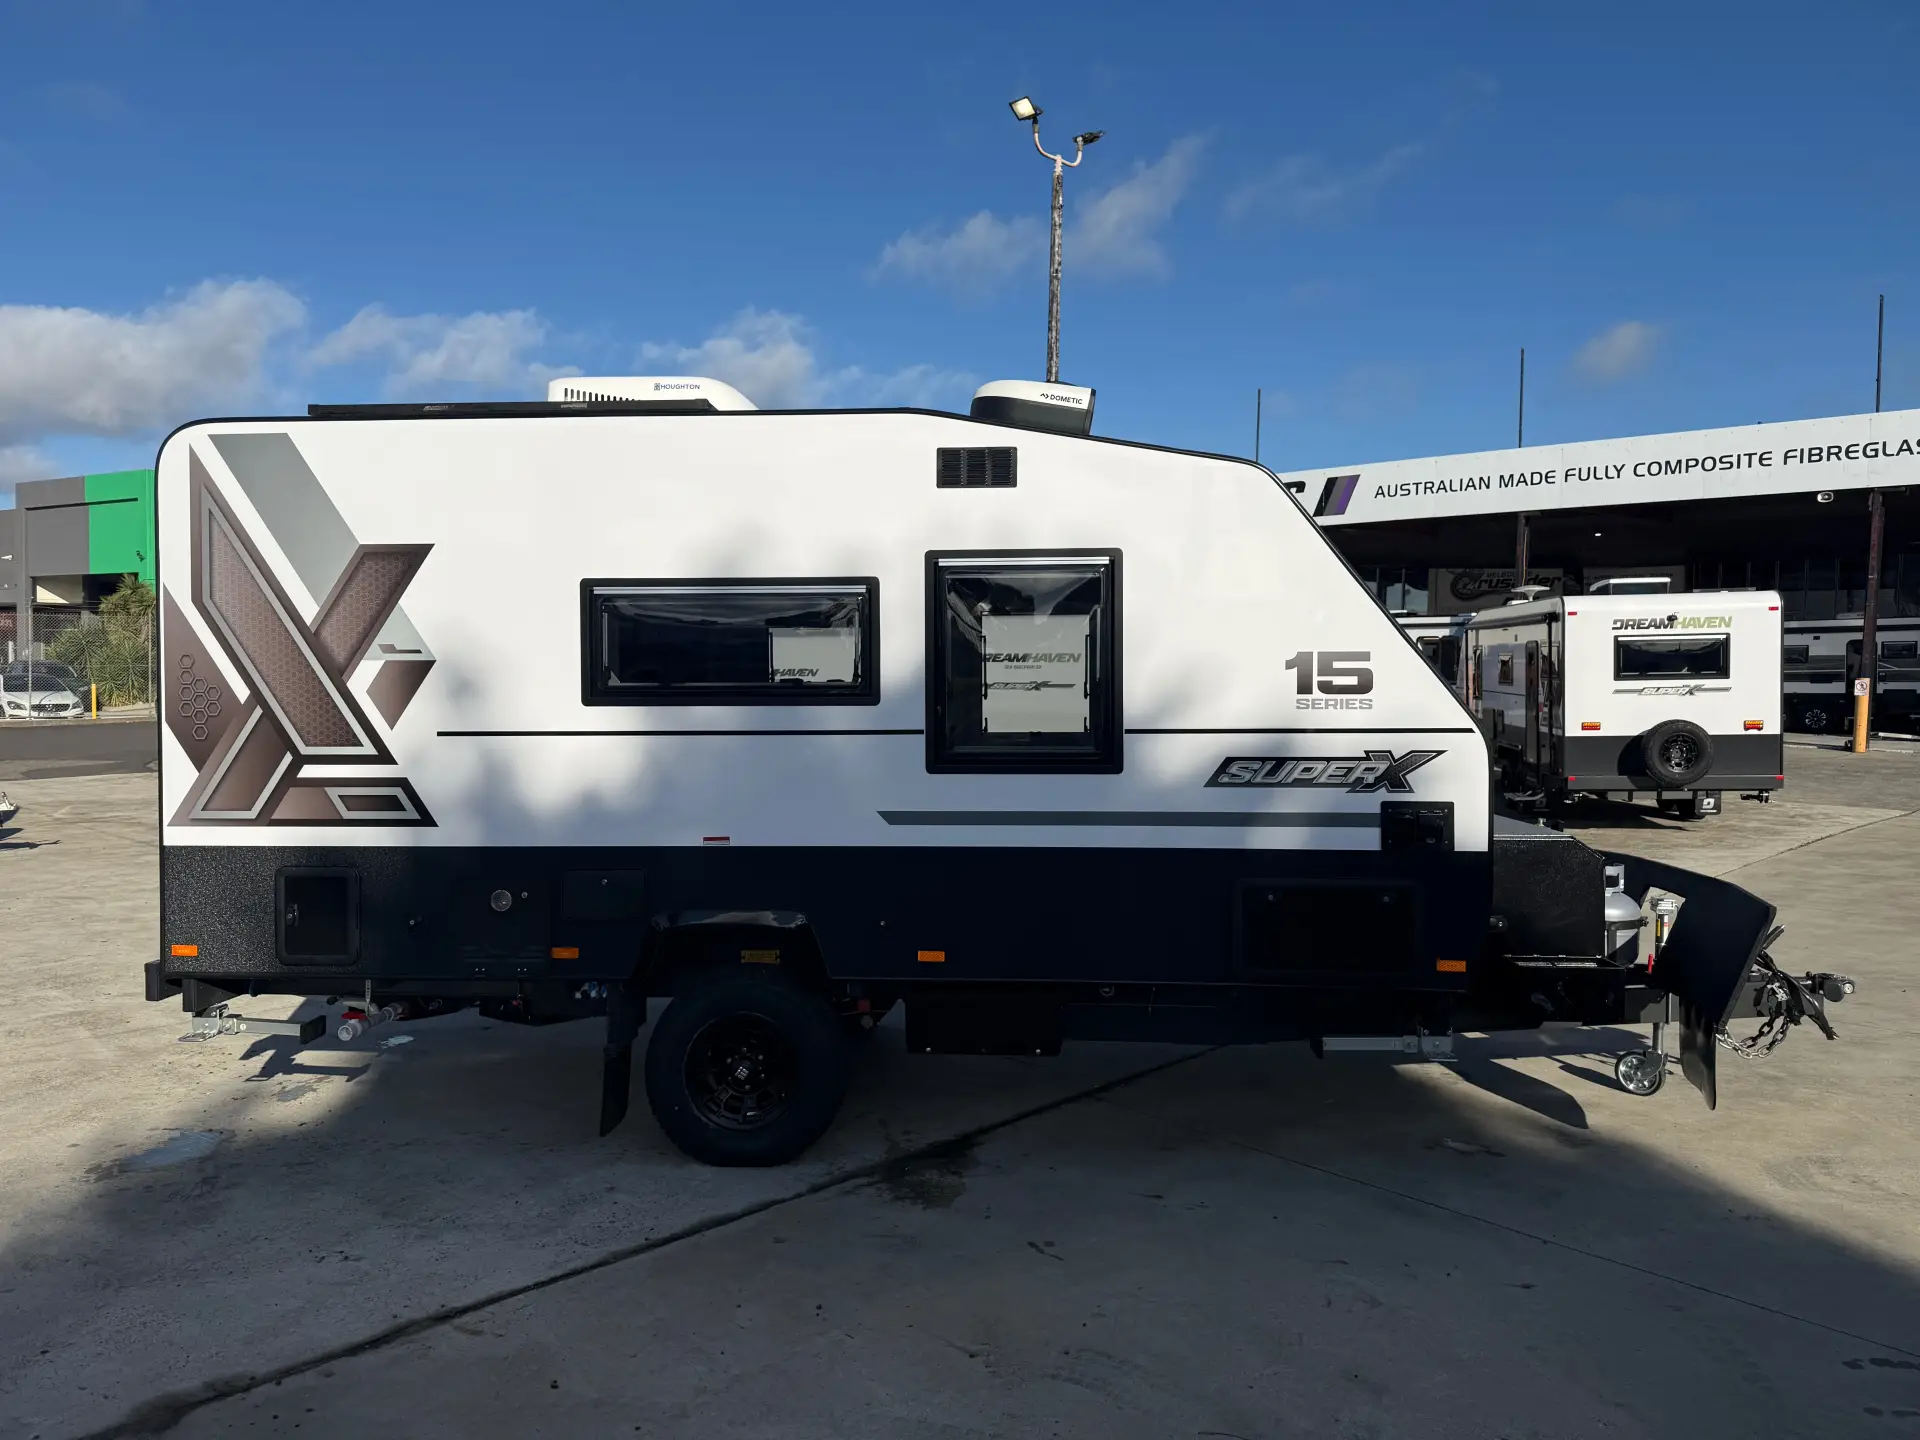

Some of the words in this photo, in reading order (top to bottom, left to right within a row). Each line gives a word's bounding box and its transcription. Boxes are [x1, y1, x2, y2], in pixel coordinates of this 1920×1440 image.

[1049, 394, 1083, 404] DOMETIC
[1374, 475, 1490, 498] AUSTRALIAN
[1499, 470, 1556, 488] MADE
[1564, 464, 1626, 482] FULLY
[1633, 451, 1773, 477] COMPOSITE
[1783, 439, 1920, 465] FIBREGLA
[1612, 616, 1732, 630] DREAMHAVEN
[982, 653, 1081, 662] REAMHAVEN
[1285, 651, 1374, 695] 15
[1296, 698, 1373, 710] SERIES
